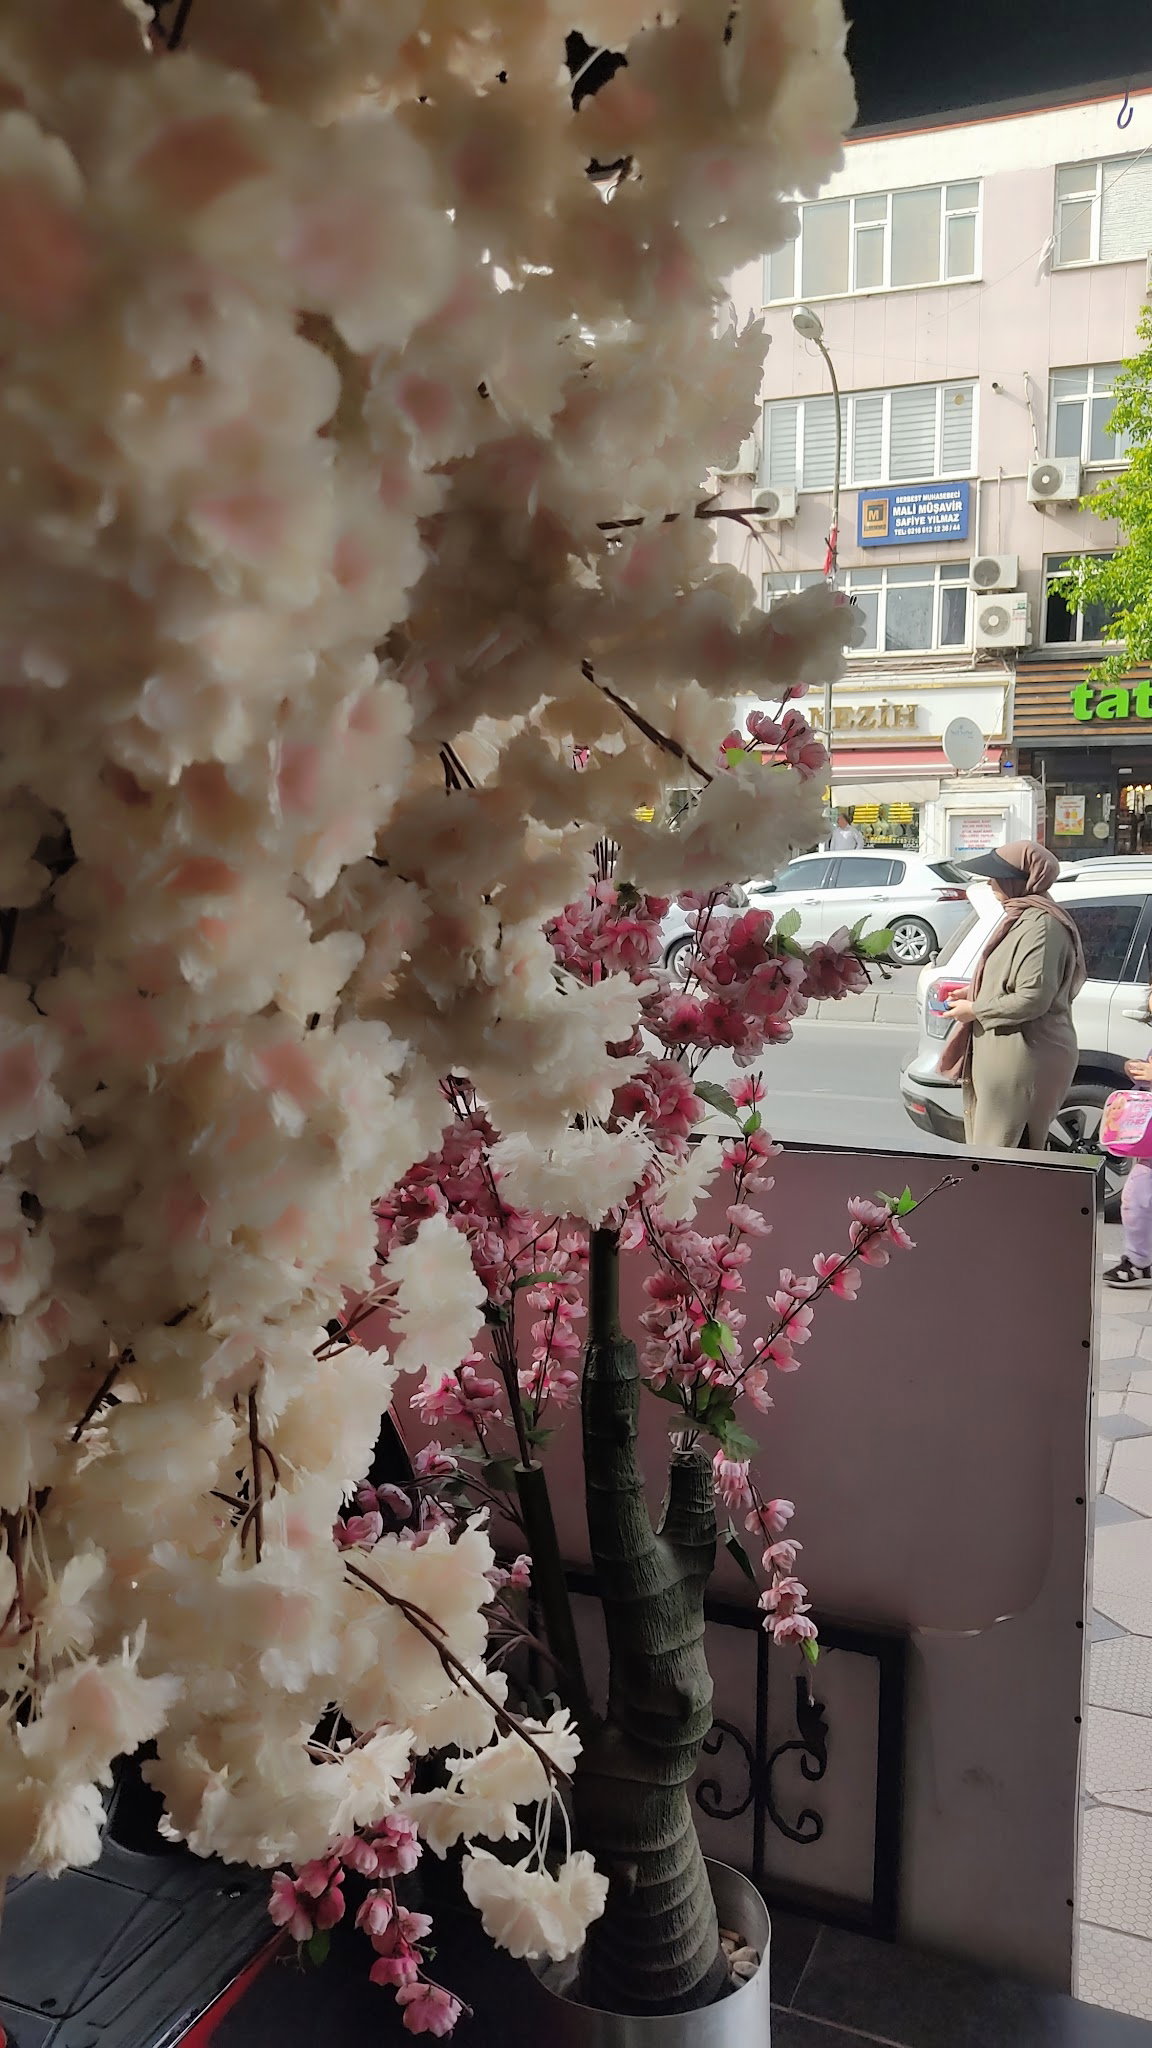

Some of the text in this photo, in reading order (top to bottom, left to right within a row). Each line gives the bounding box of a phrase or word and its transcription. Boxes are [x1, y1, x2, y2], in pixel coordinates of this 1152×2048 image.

[893, 501, 962, 515] MALİ MÜŞAVİR
[896, 514, 959, 526] SAFİYE YILMAZ
